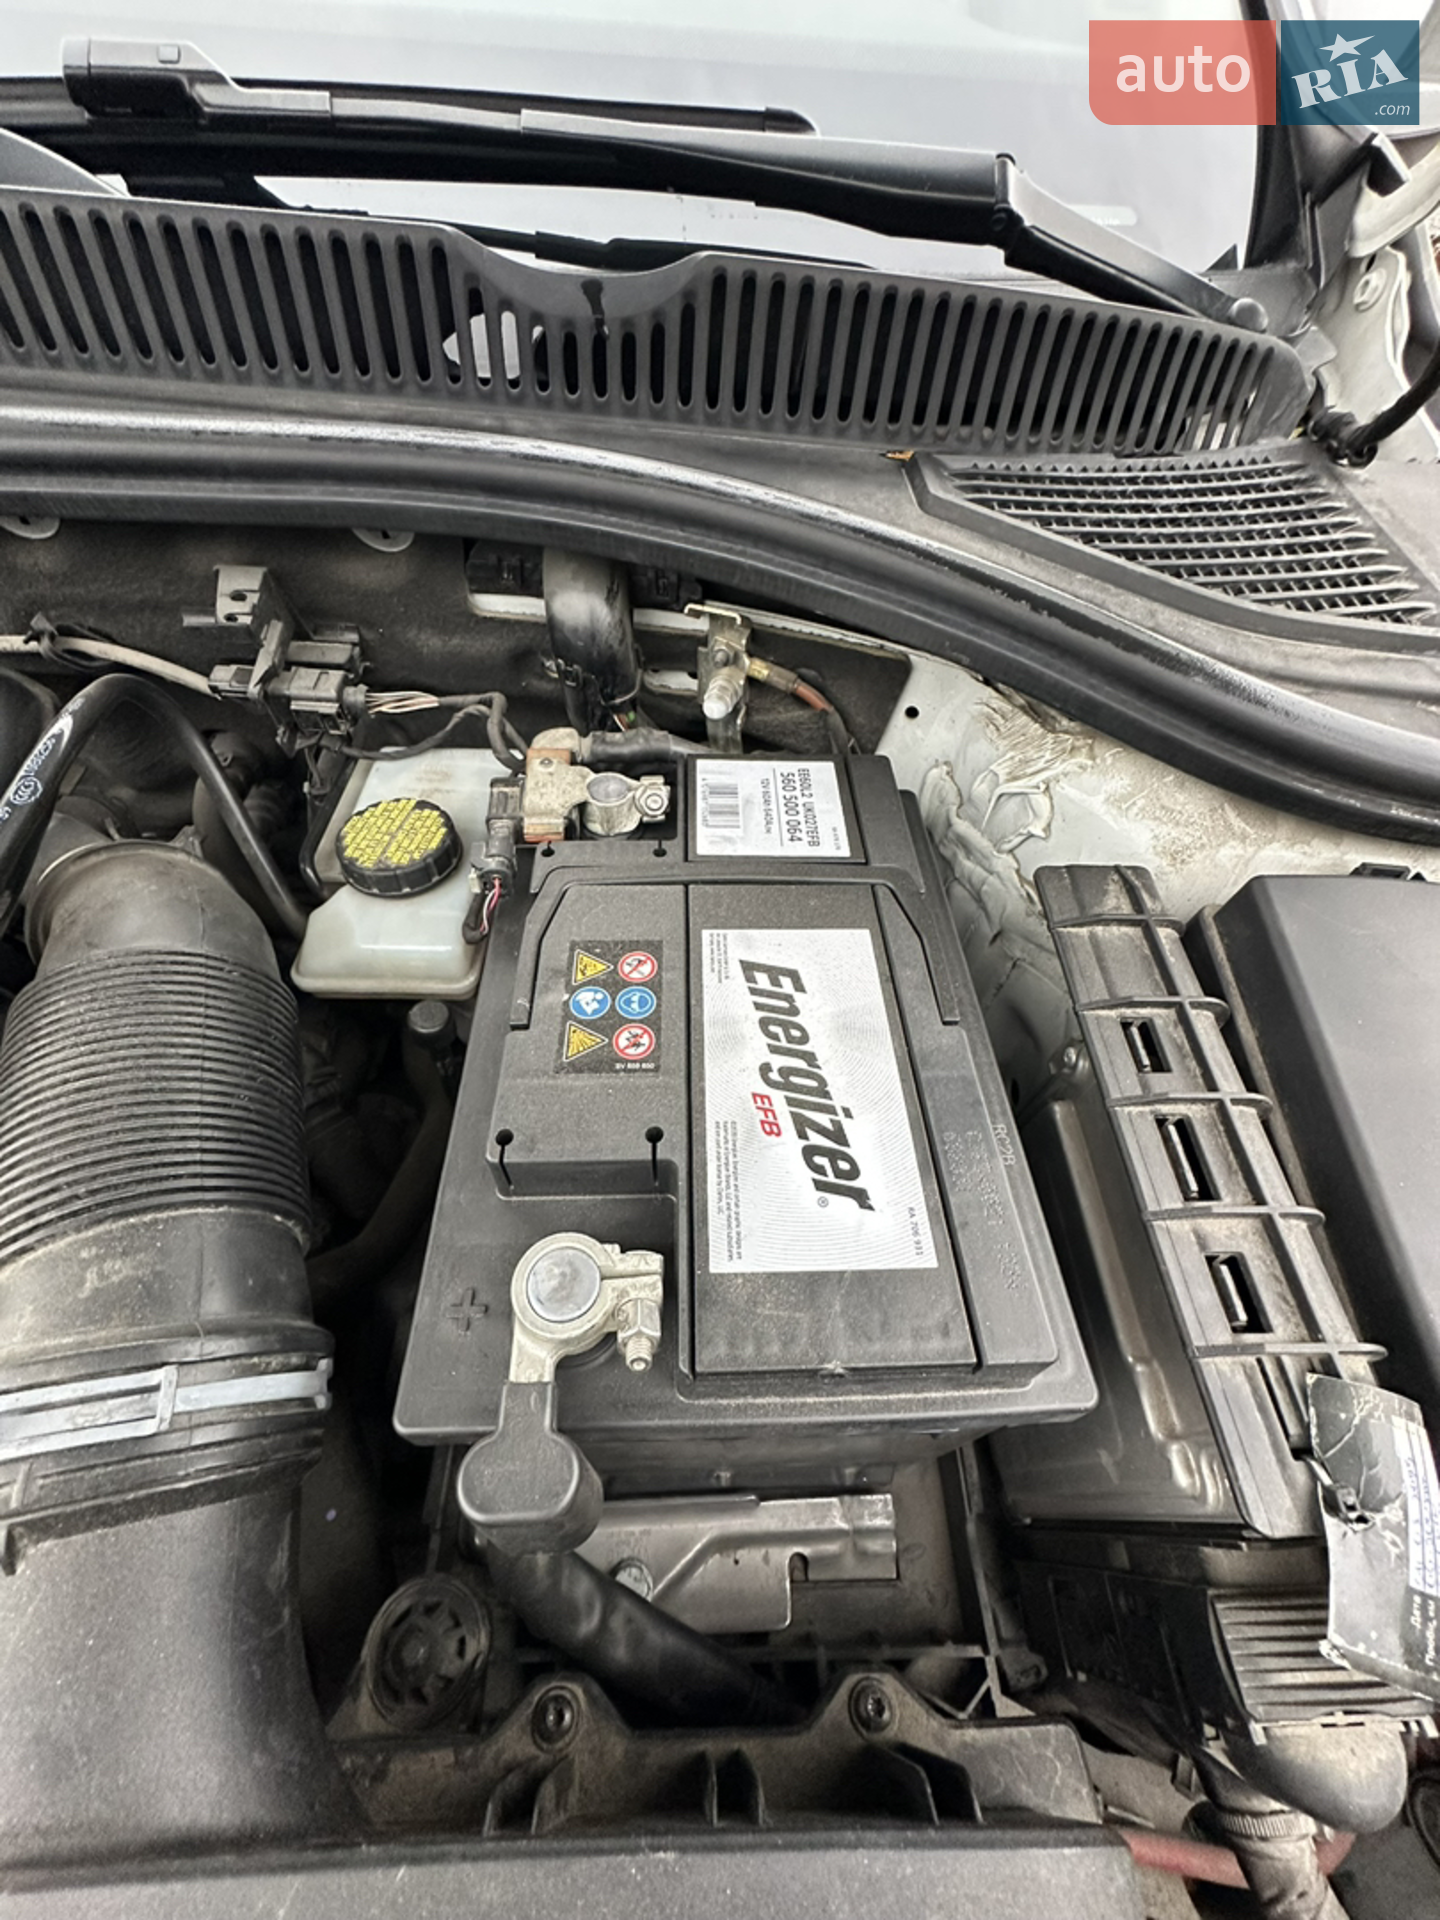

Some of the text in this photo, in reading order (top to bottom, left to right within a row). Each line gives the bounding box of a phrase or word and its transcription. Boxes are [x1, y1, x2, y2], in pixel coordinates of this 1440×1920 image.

[780, 772, 803, 842] 560 500 064
[739, 959, 875, 1211] Energizer
[751, 1092, 782, 1137] EFB
